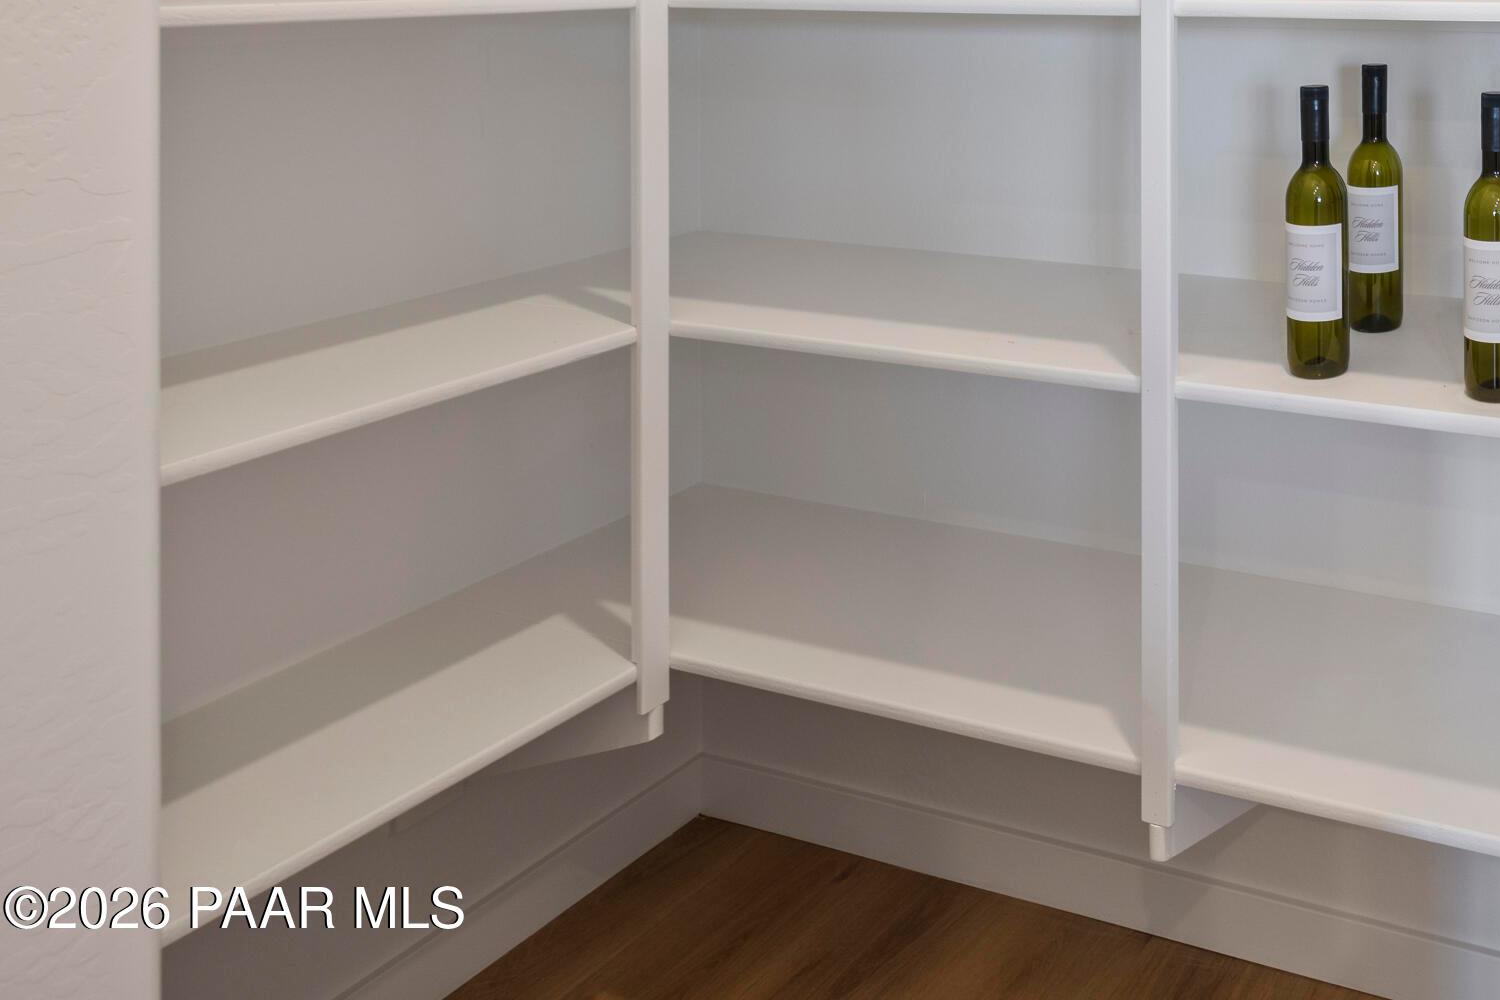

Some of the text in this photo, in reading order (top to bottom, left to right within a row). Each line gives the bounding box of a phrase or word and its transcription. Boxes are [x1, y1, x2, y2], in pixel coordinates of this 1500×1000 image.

[1352, 216, 1384, 229] Hidden
[1354, 230, 1380, 243] Hills
[1288, 257, 1325, 272] Hidden
[1292, 273, 1320, 287] Hills
